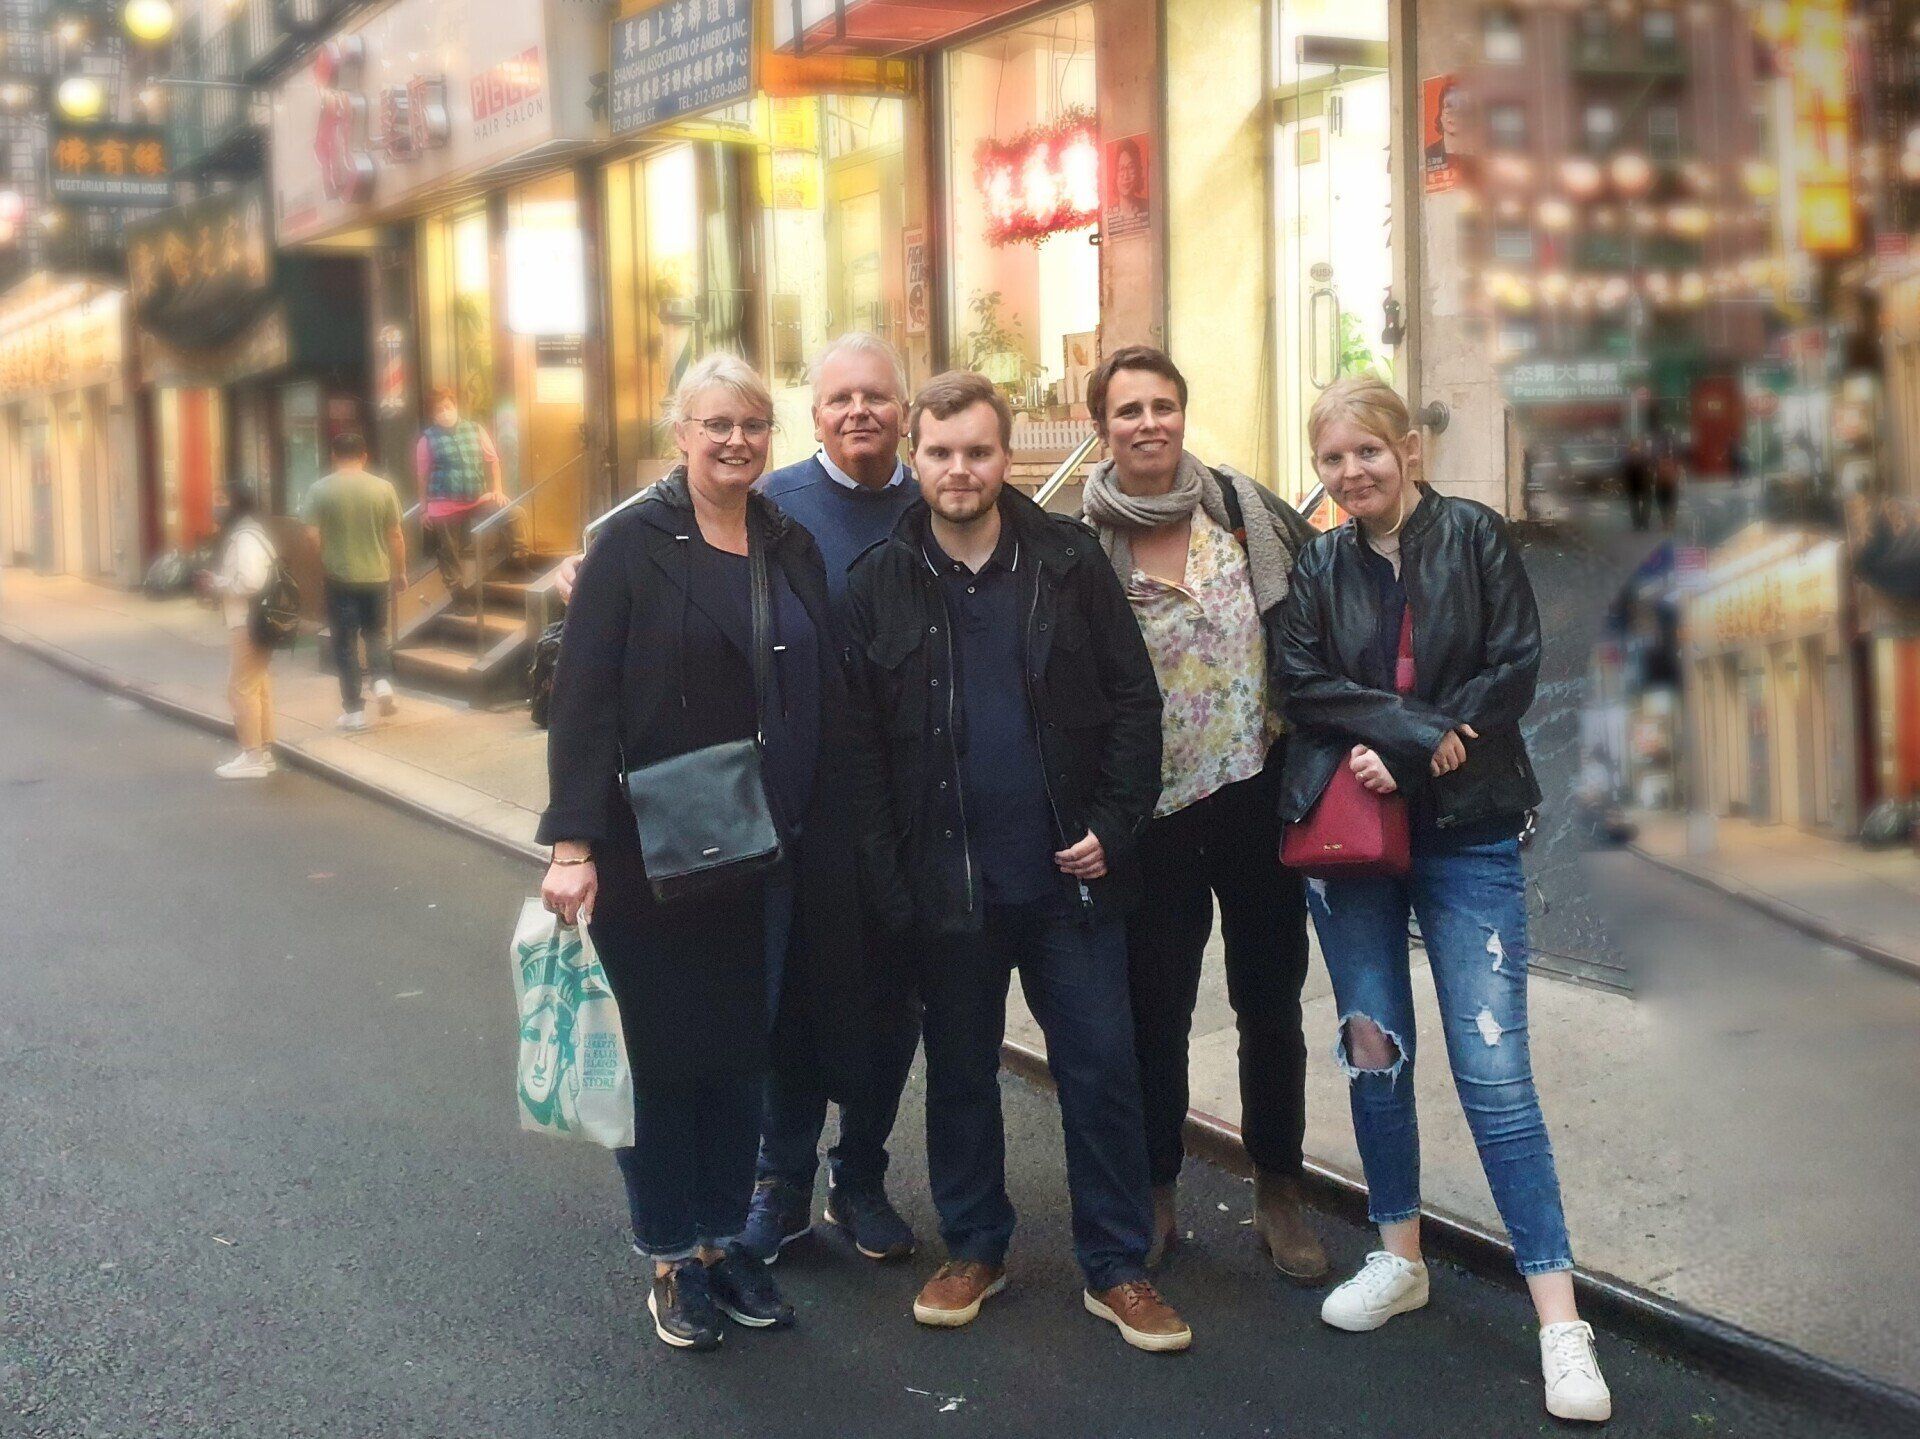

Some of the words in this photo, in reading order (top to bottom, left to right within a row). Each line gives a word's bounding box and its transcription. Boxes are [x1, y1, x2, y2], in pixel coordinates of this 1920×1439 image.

[613, 59, 647, 86] SHANGHAI
[647, 40, 689, 72] ASSOCIATION
[689, 36, 700, 57] OF
[701, 25, 731, 52] AMERICA
[678, 94, 693, 111] TEL:
[473, 118, 501, 142] HAIR
[505, 98, 544, 129] SALON
[55, 179, 105, 193] VEGETARIAN
[106, 181, 121, 193] DIM
[141, 183, 169, 195] HOUSE
[1514, 385, 1578, 398] Paradigm
[1580, 383, 1623, 396] Health
[582, 1077, 614, 1088] STORE
